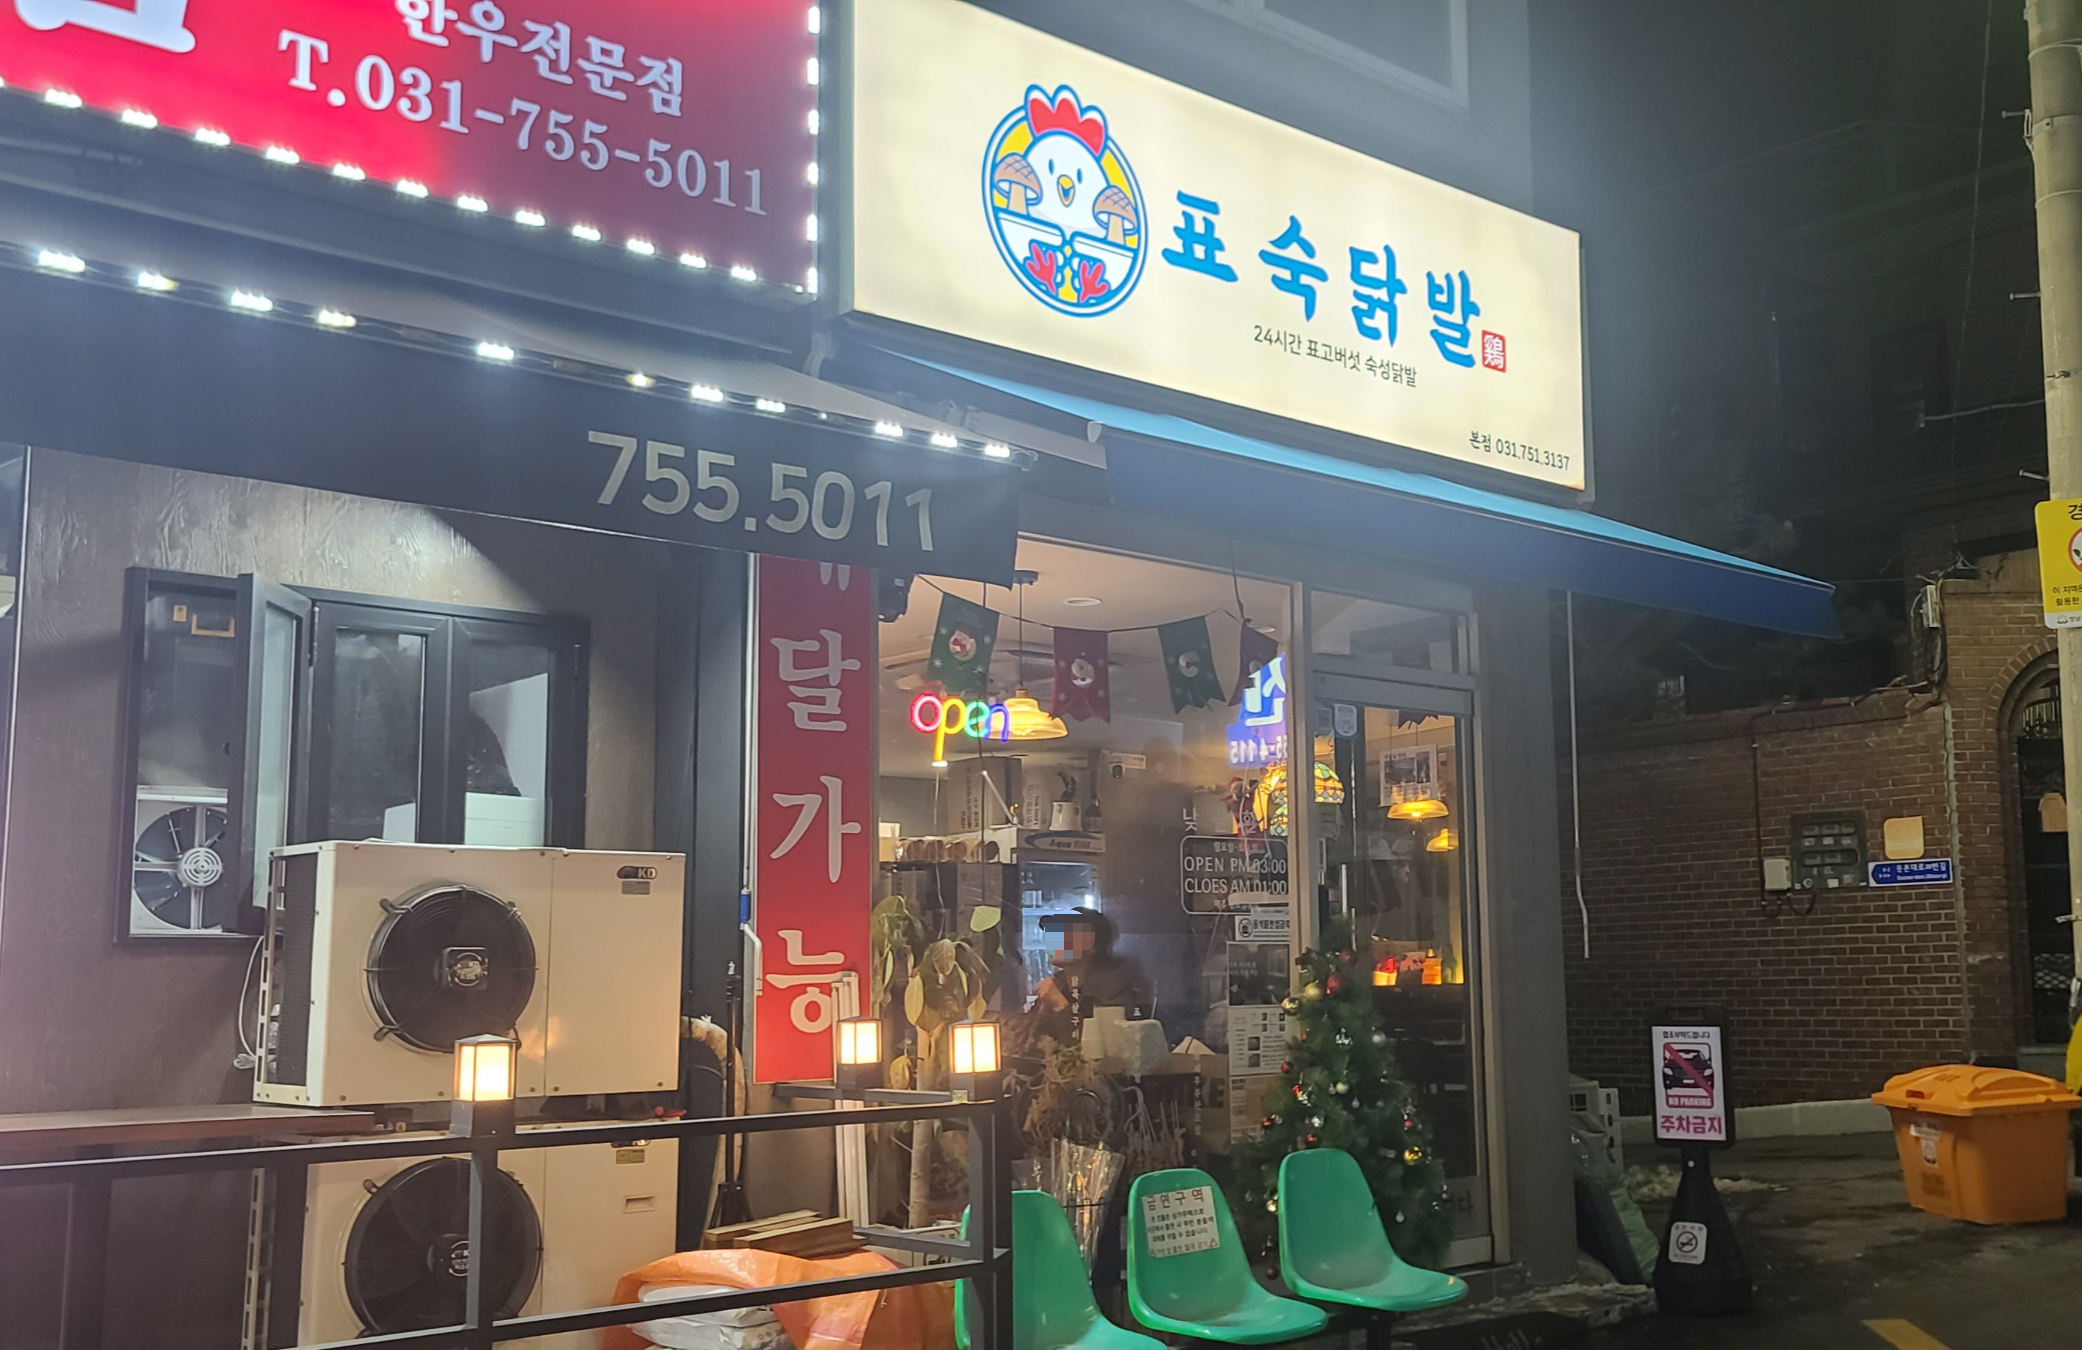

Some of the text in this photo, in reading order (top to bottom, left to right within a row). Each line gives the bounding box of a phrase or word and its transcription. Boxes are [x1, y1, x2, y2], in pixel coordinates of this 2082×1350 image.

[395, 0, 684, 117] 한우전문점
[278, 29, 768, 216] T.031-755-5011
[1253, 324, 1418, 388] 24시간 표고버섯 숙성닭발
[1469, 430, 1571, 471] 본점 031.751.3137
[588, 430, 934, 551] 755.5011
[2052, 586, 2061, 595] 이
[909, 692, 1011, 767] open
[765, 562, 862, 1034] 달가능
[1184, 856, 1224, 872] OPEN
[1230, 858, 1249, 872] PM
[1184, 877, 1287, 895] CLOES AM 01:00
[1660, 1115, 1723, 1135] 주차금지
